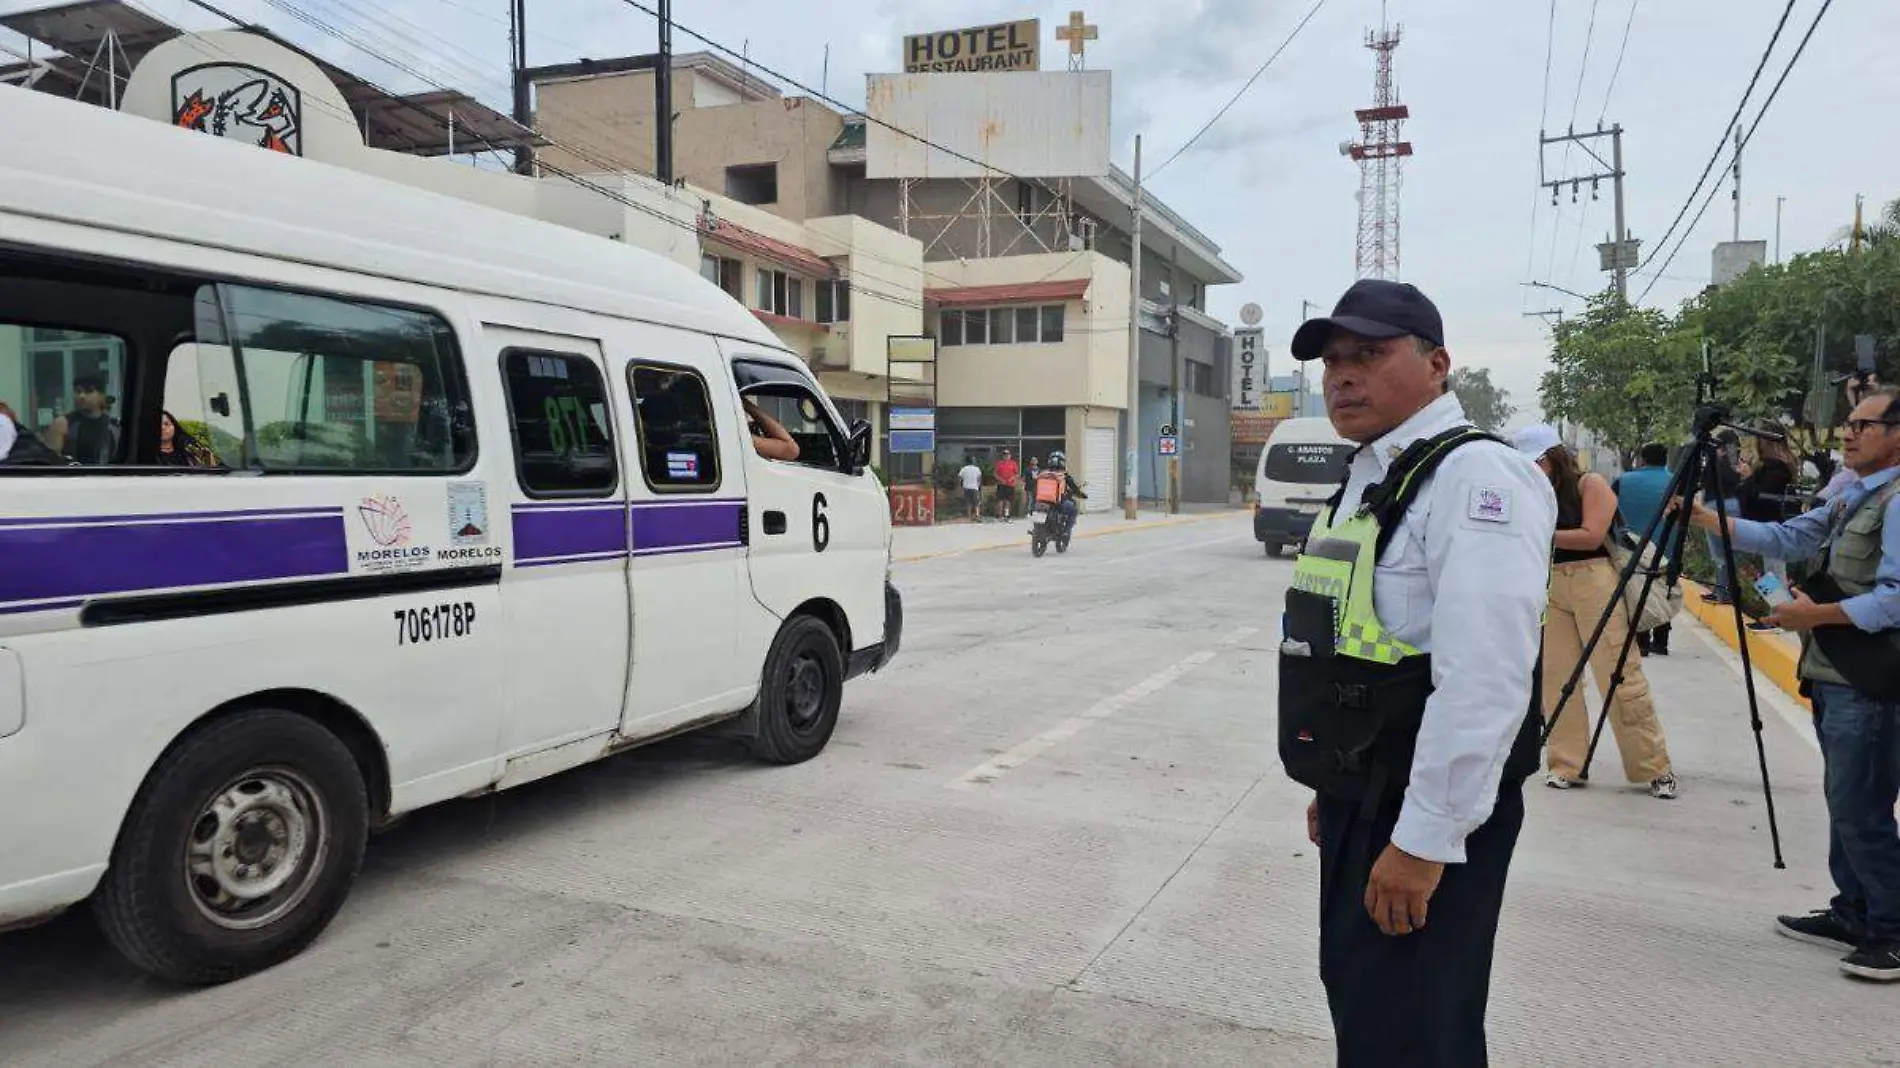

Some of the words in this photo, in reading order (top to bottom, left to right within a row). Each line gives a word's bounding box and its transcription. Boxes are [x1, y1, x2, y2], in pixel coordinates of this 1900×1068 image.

[911, 23, 1028, 62] HOTEL
[906, 50, 1033, 73] RESTAURANT
[1241, 336, 1255, 405] HOTEL
[1298, 445, 1334, 455] ABASTOS
[812, 491, 829, 553] 6
[357, 547, 431, 561] MORELOS
[437, 546, 502, 560] MORELOS
[394, 601, 476, 647] 706178P
